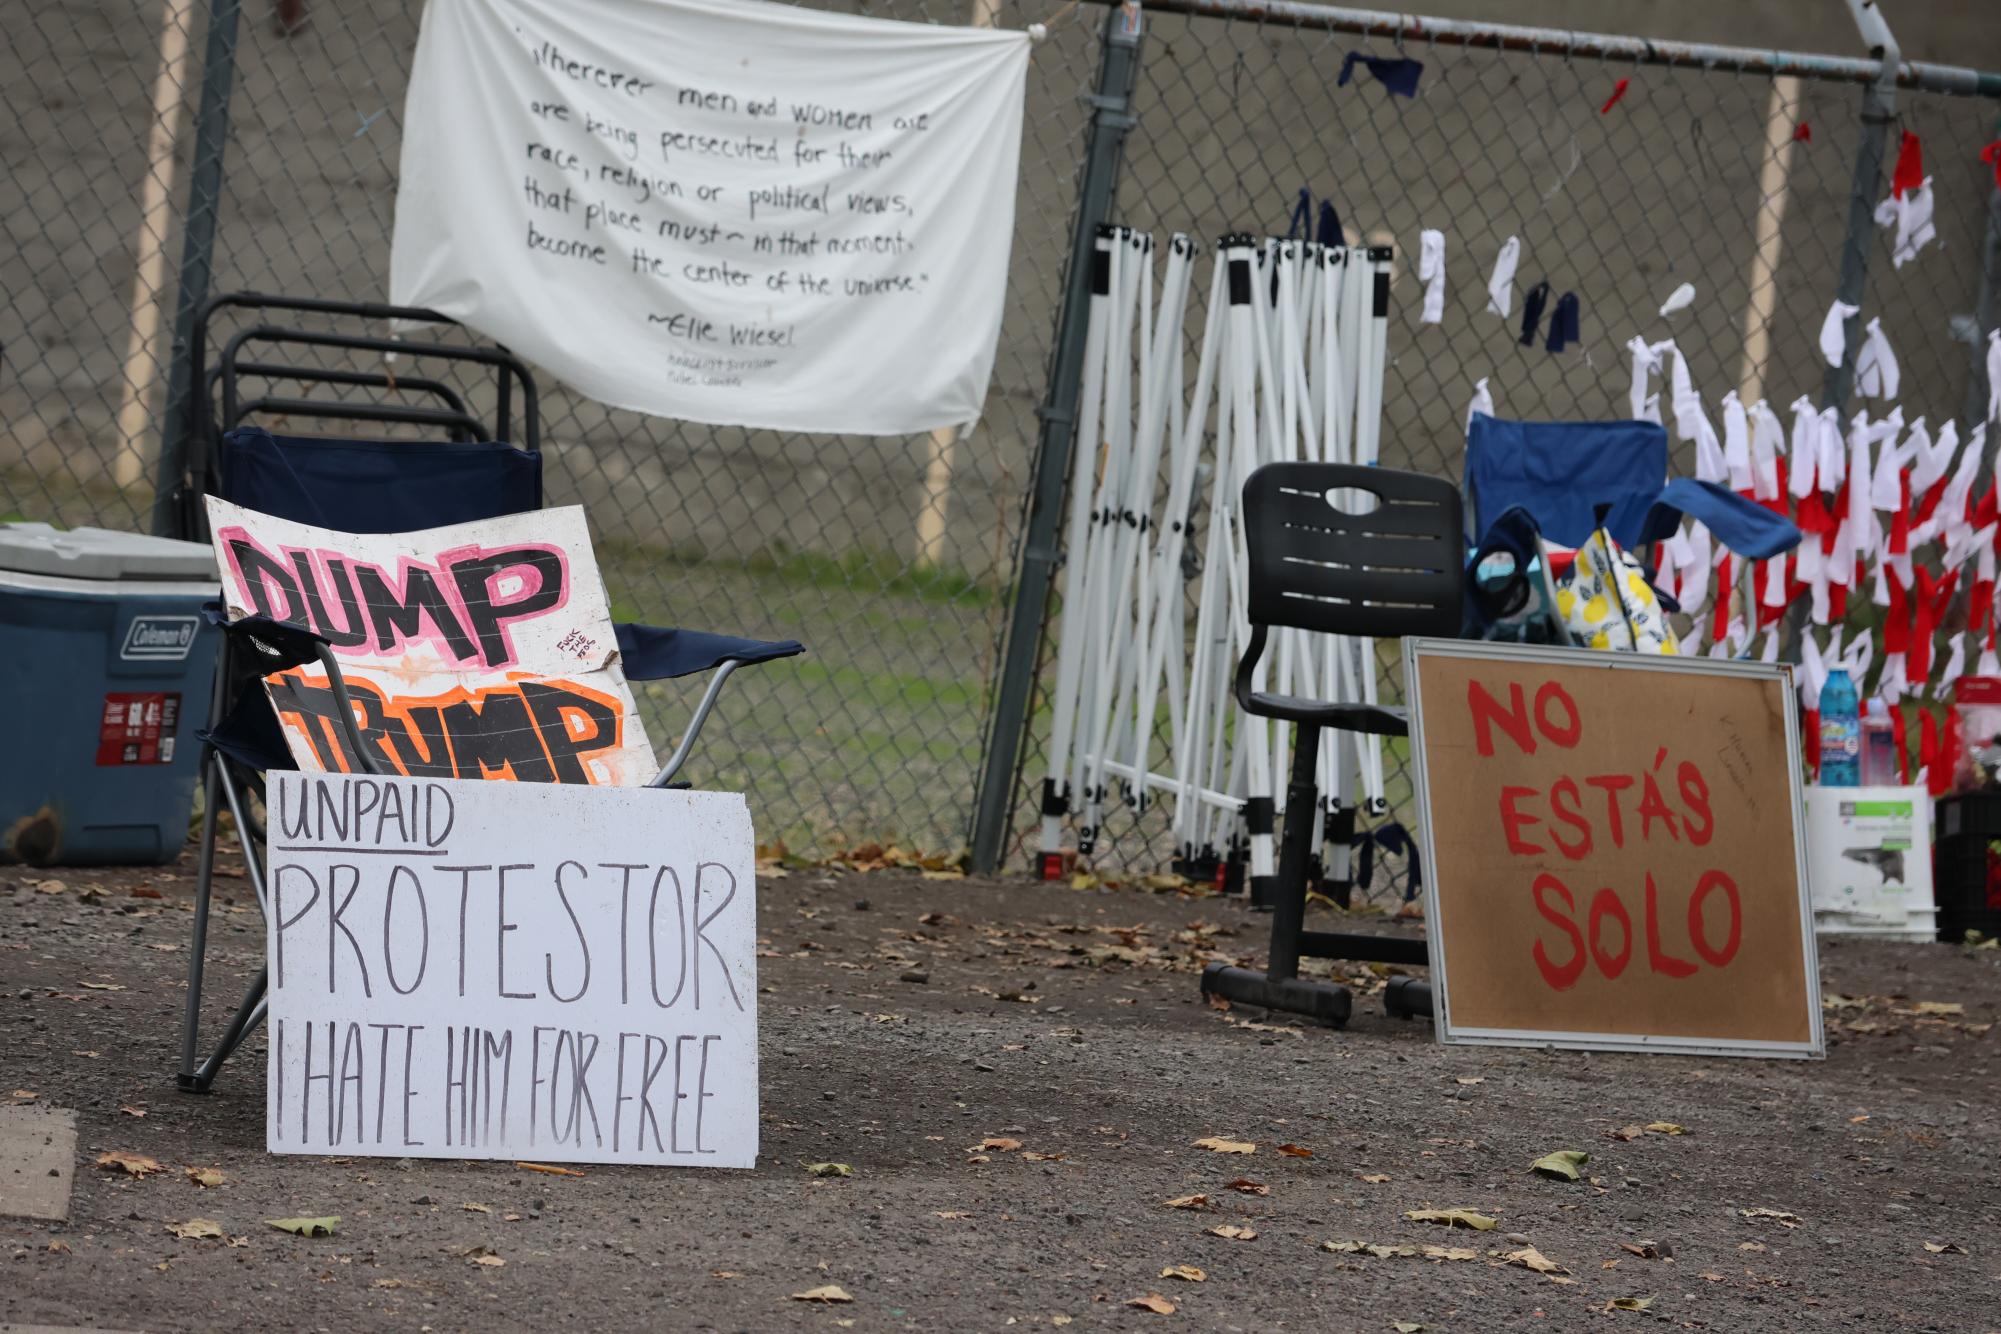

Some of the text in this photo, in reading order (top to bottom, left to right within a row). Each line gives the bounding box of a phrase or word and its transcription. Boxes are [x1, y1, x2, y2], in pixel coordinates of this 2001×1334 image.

[531, 101, 570, 122] are
[661, 130, 780, 164] persecuted
[794, 138, 828, 168] for
[678, 88, 737, 113] men
[747, 97, 777, 117] and
[524, 175, 579, 214] that
[585, 200, 642, 233] place
[657, 219, 721, 245] must
[778, 231, 819, 257] that
[601, 164, 684, 204] religion
[697, 184, 724, 202] or
[749, 183, 830, 220] political
[527, 220, 607, 265] become
[632, 247, 670, 277] the
[683, 261, 752, 287] center
[766, 271, 790, 293] of
[798, 272, 831, 295] the
[729, 323, 797, 347] Wiesel
[218, 526, 570, 675] DUMP
[556, 628, 581, 652] FUCK
[568, 634, 587, 652] THE
[264, 670, 625, 787] TRUMP
[1468, 679, 1582, 757] NO
[279, 776, 455, 848] UNPAID
[1500, 746, 1715, 861] ESTÁS
[274, 859, 746, 1012] PROTESTOR
[1532, 869, 1742, 993] SOLO
[276, 1018, 723, 1155] I HATE HIM FOR FREE
